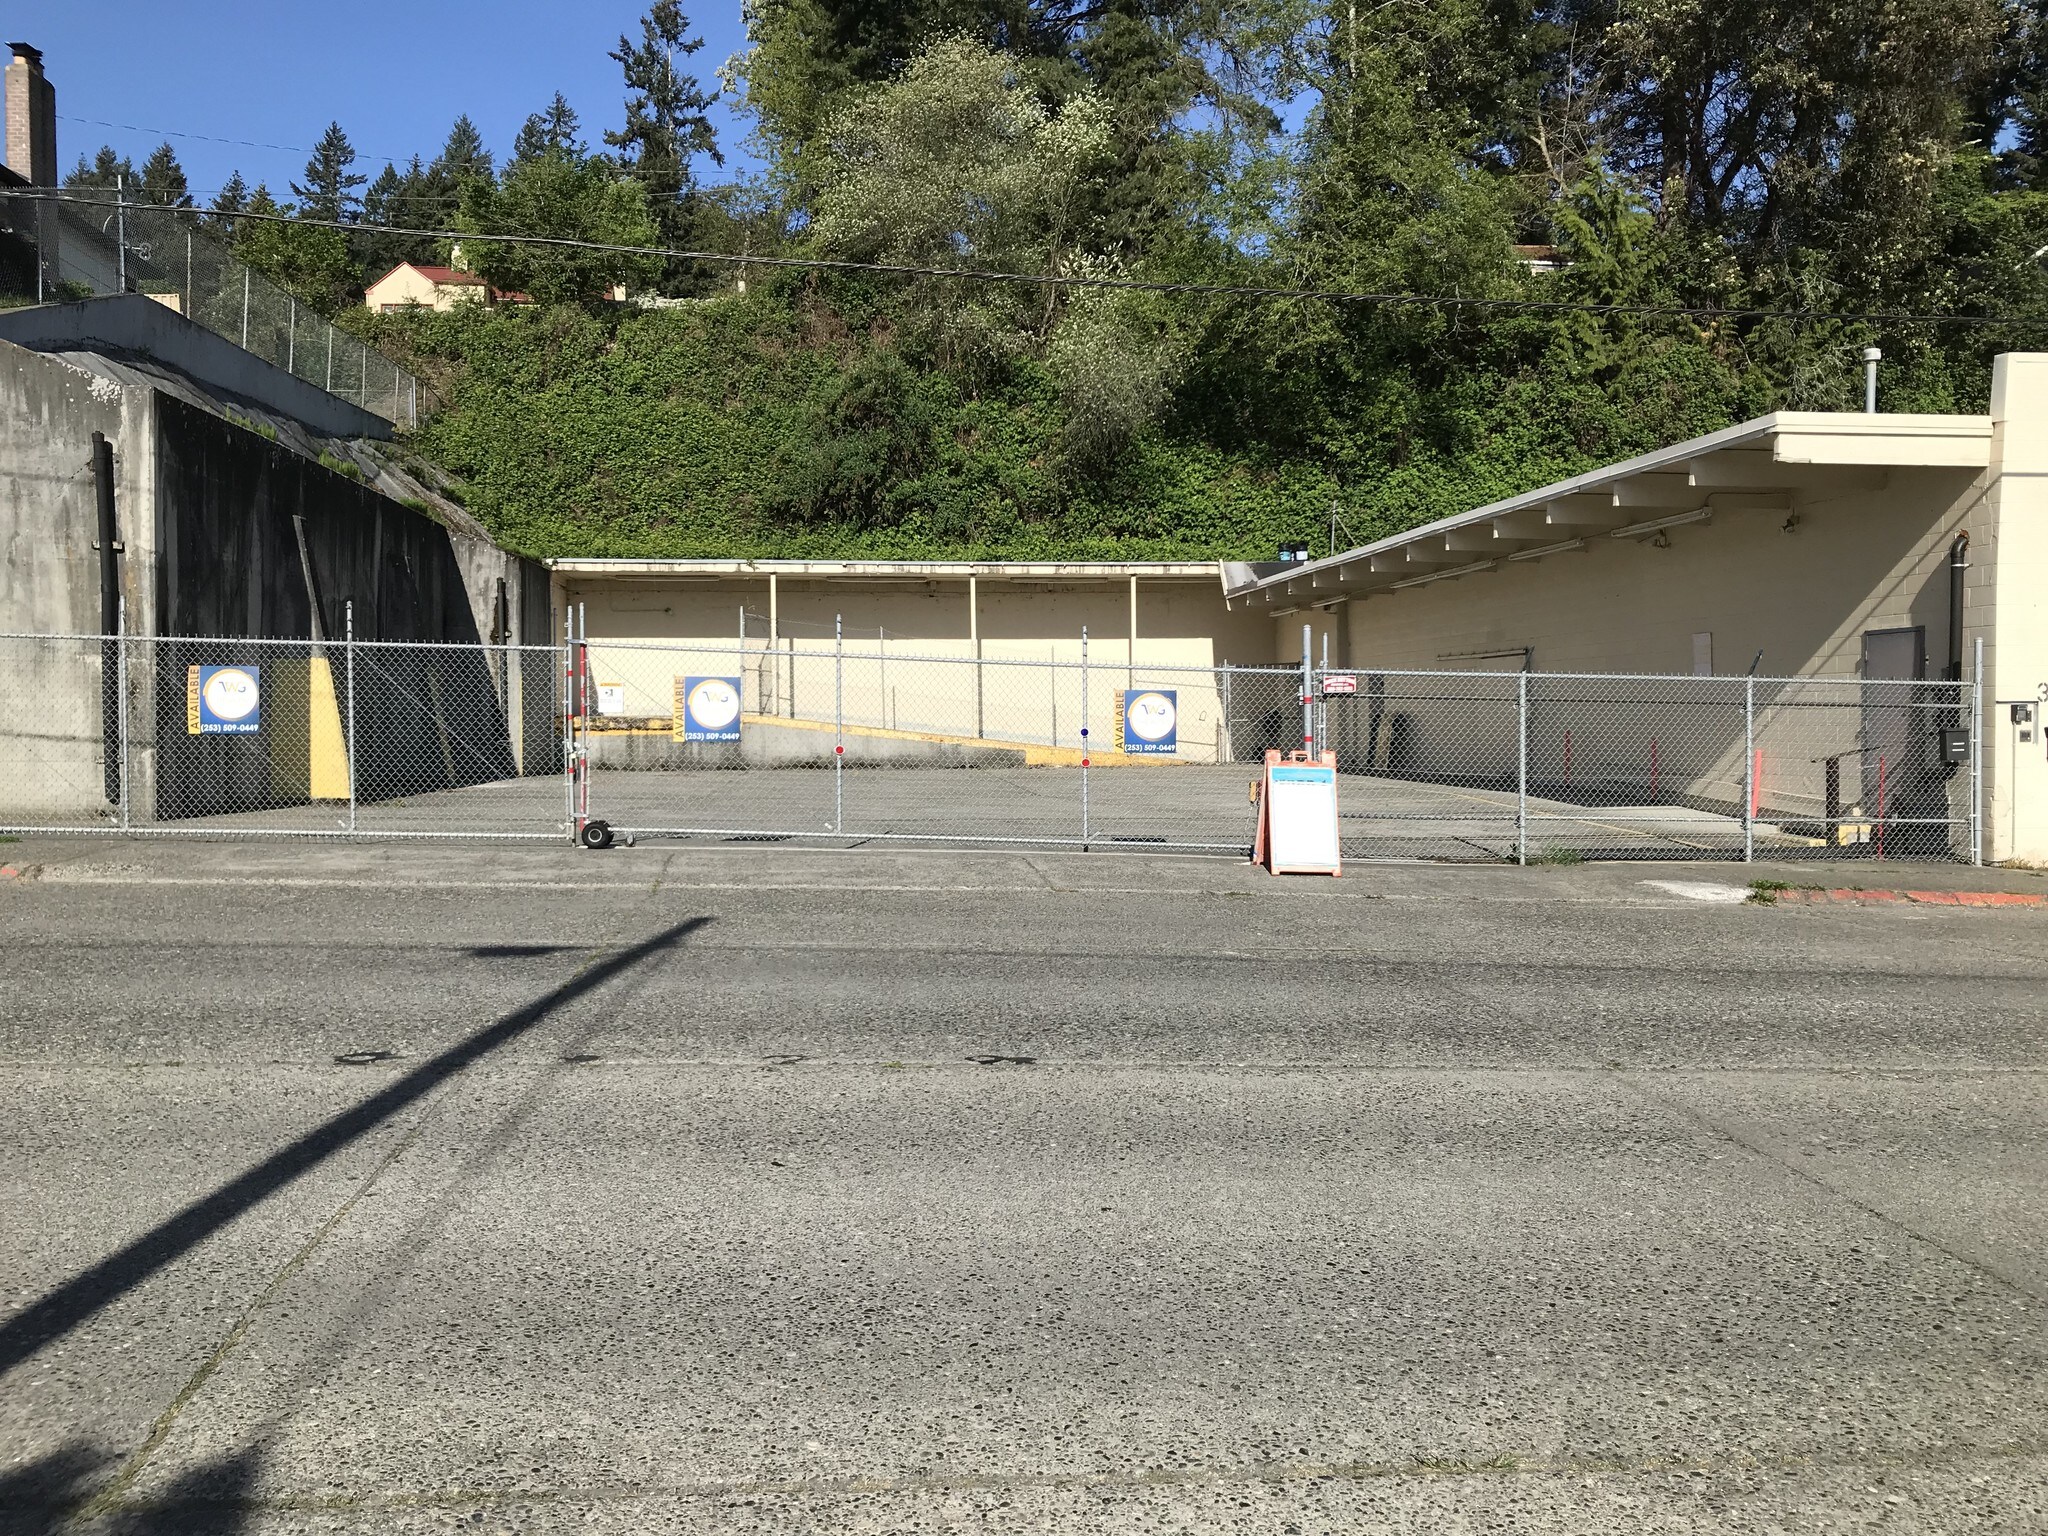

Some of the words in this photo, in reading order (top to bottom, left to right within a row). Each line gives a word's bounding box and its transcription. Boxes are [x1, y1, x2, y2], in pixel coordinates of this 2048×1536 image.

[190, 669, 199, 729] AVAILABLE
[675, 679, 684, 737] AVAILABLE
[201, 724, 221, 733] (253)
[223, 724, 258, 732] 509-0449
[685, 732, 704, 741] (253)
[706, 732, 740, 740] 509-0449
[1115, 692, 1124, 749] AVAILABLE
[1124, 744, 1142, 752] (253)
[1144, 744, 1176, 752] 509-0449
